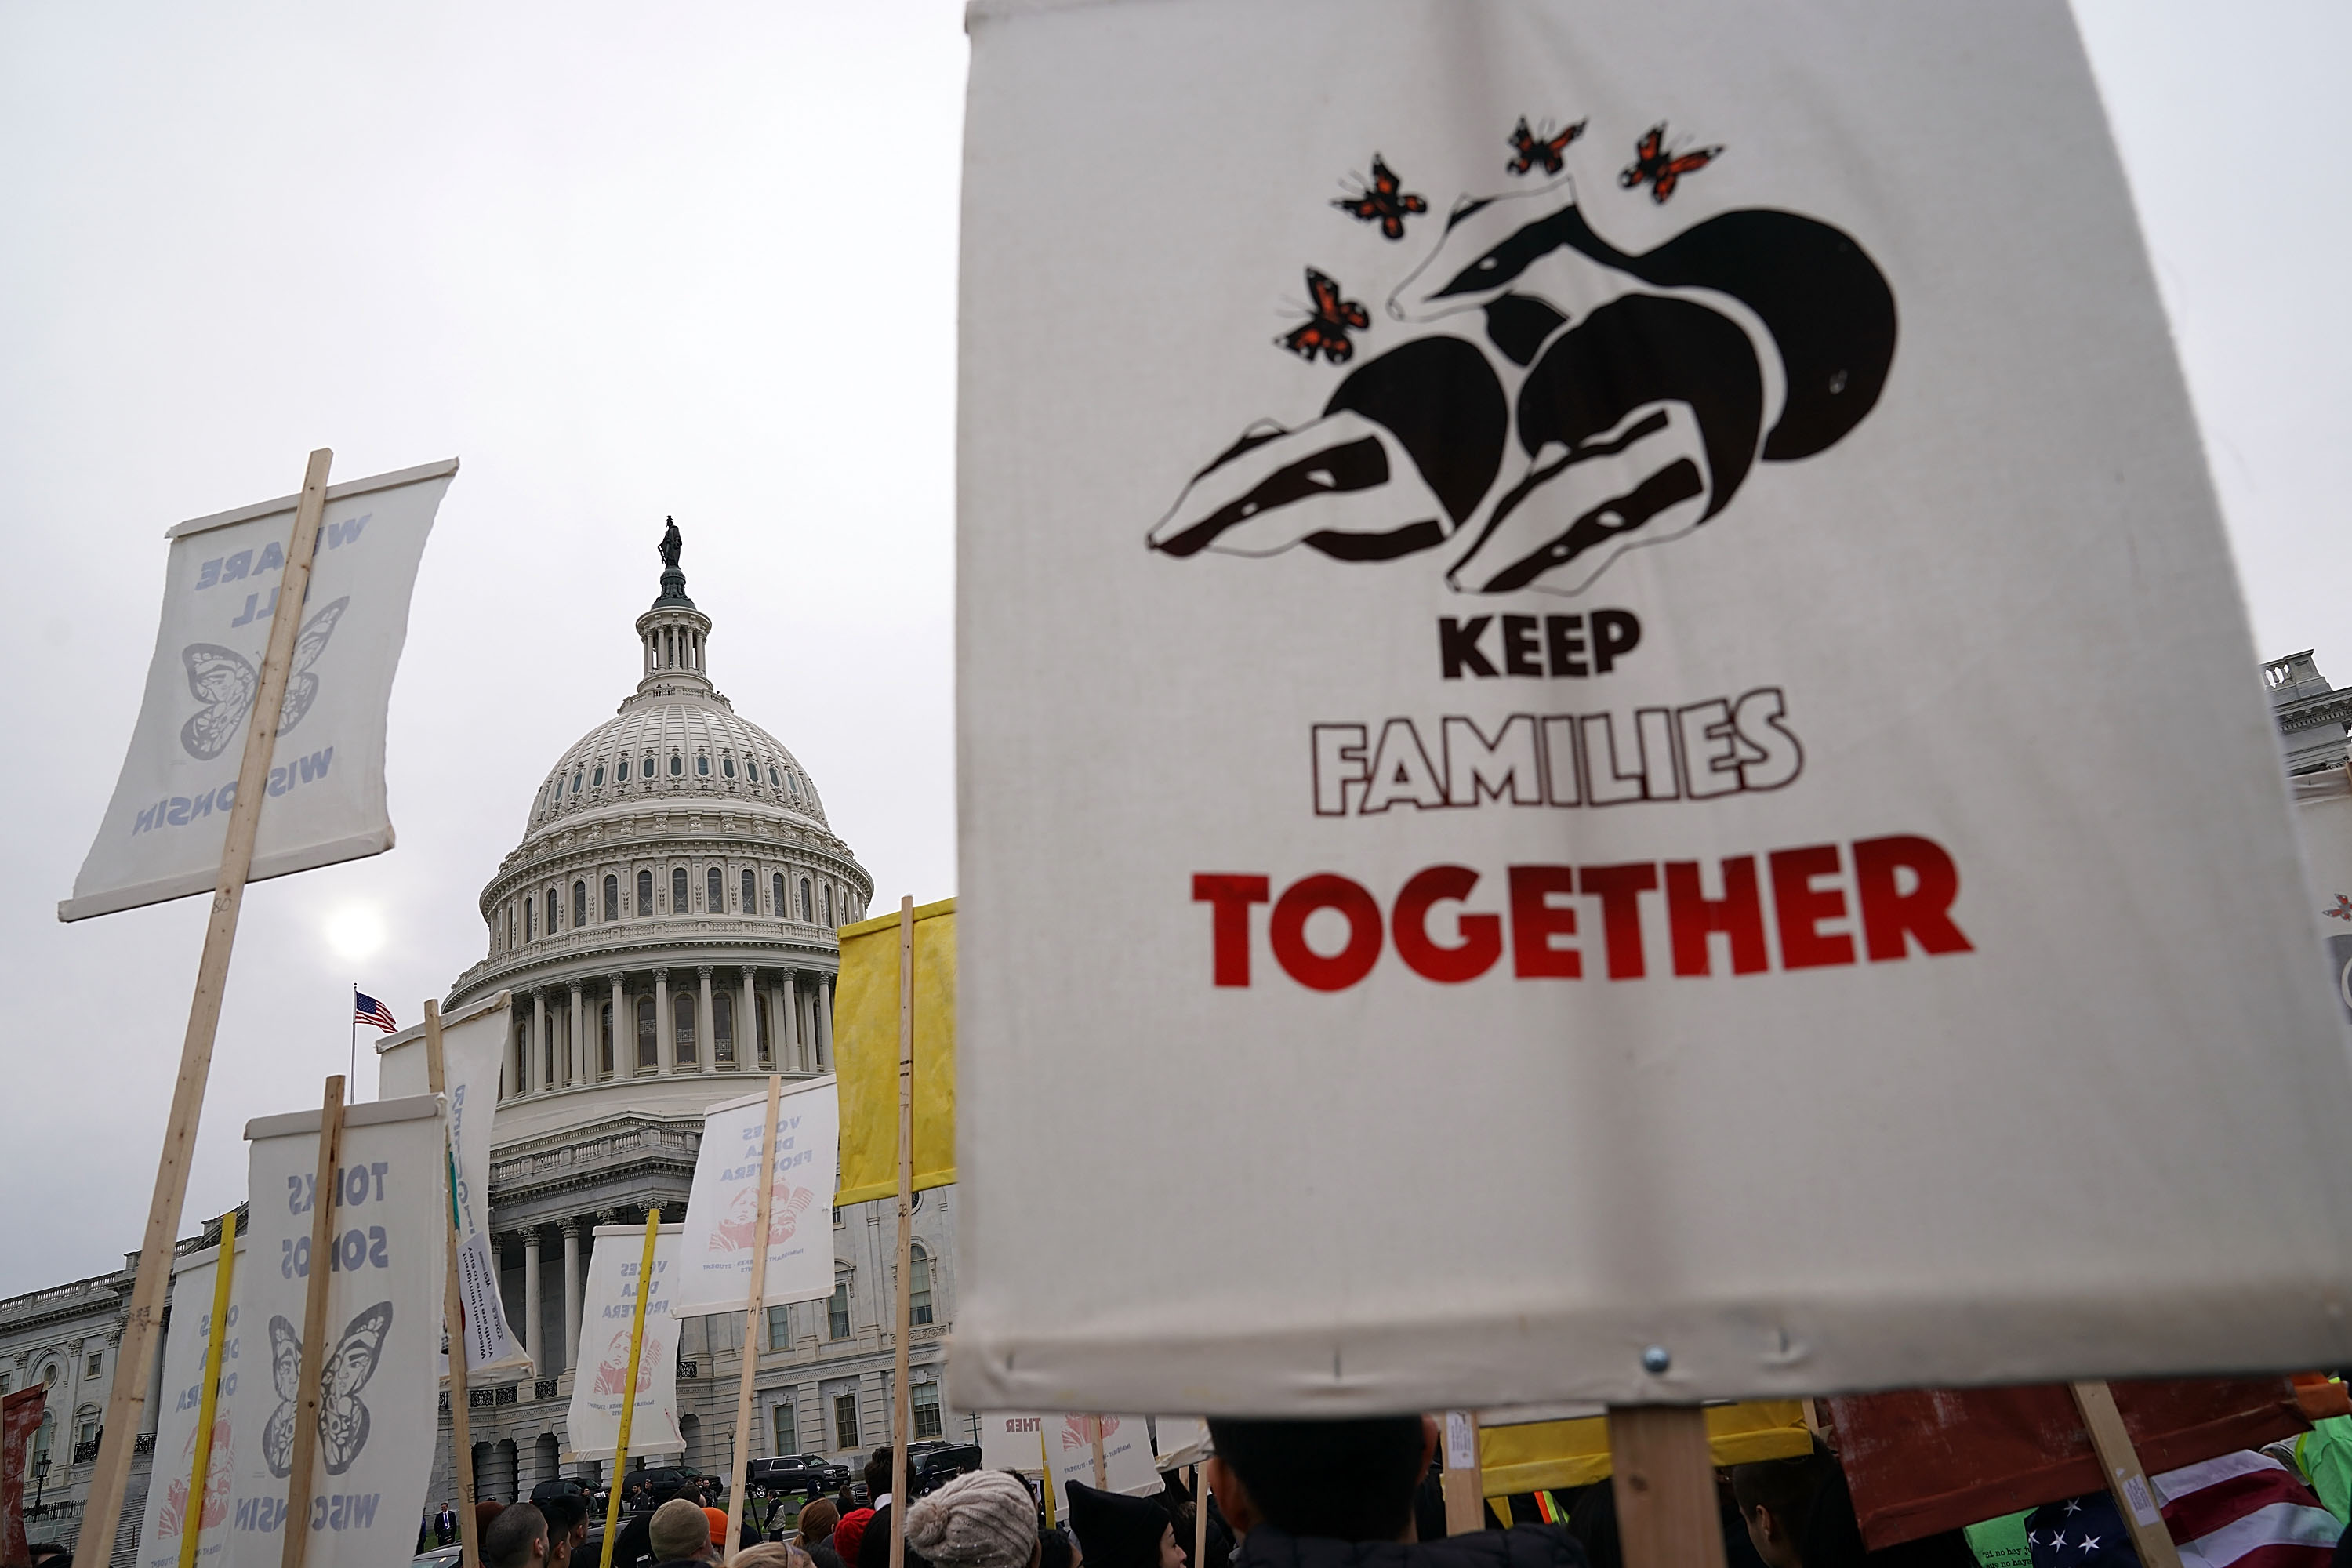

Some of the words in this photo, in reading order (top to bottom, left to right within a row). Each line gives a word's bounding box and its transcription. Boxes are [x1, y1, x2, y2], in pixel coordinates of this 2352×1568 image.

[1436, 609, 1642, 680] KEEP
[1311, 687, 1806, 817] FAMILIES
[1191, 833, 1976, 993] TOGETHER
[463, 1253, 476, 1305] Immigrant
[474, 1270, 478, 1281] to
[474, 1306, 486, 1359] Wisconsin
[485, 1326, 493, 1358] Youth
[2006, 1548, 2021, 1556] hay
